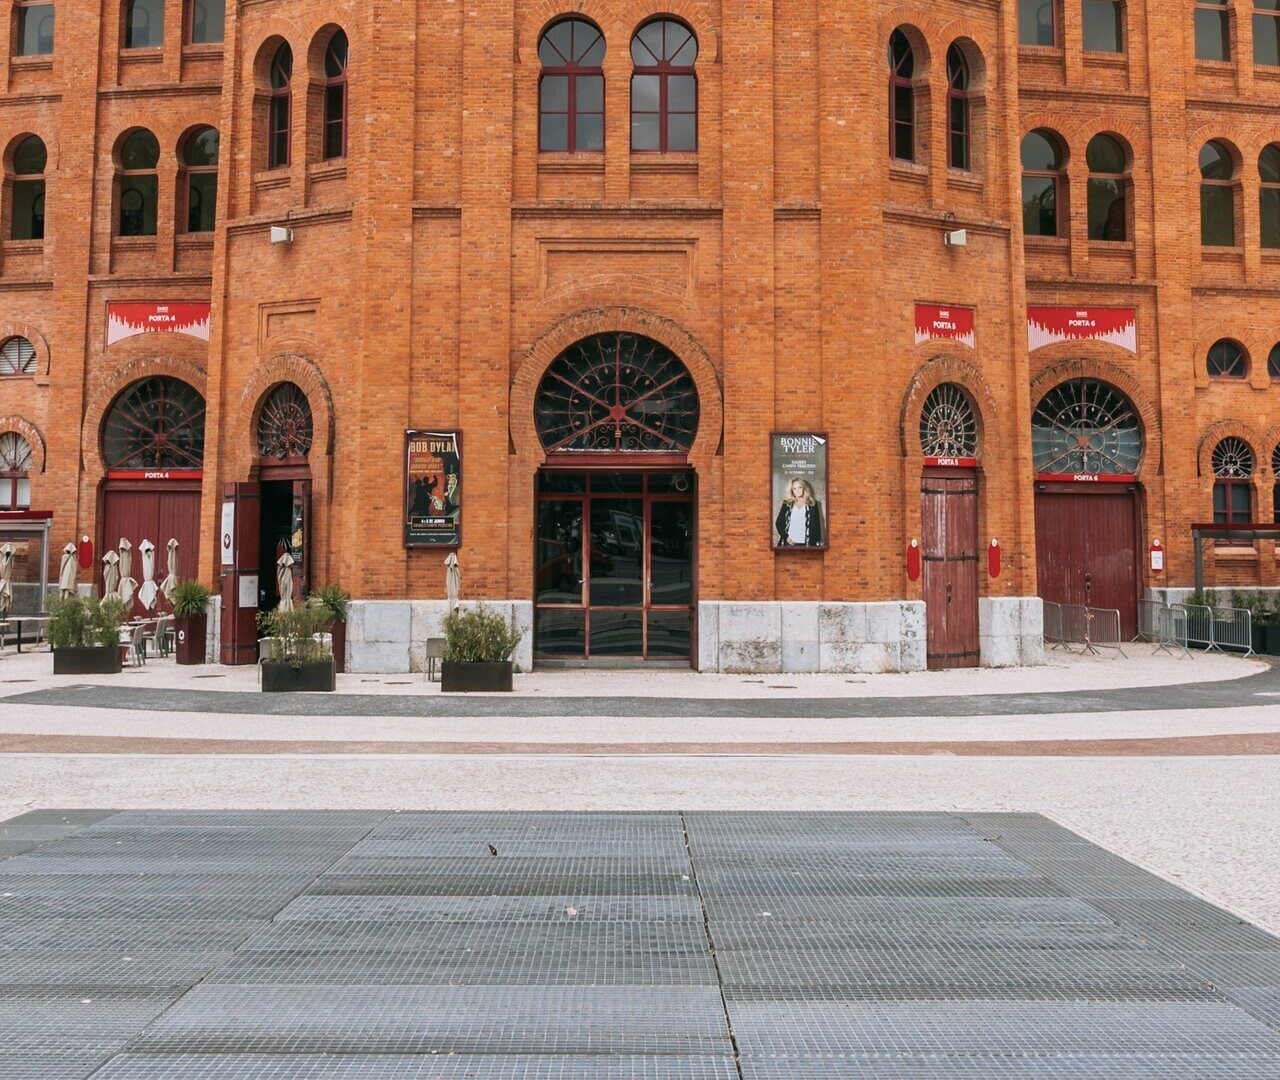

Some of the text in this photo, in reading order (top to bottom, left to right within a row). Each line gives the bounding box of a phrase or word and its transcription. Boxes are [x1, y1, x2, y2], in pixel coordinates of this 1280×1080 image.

[933, 321, 951, 329] PORTA
[781, 437, 818, 445] BONNIE
[410, 442, 428, 452] BOB
[784, 445, 815, 453] TYLER
